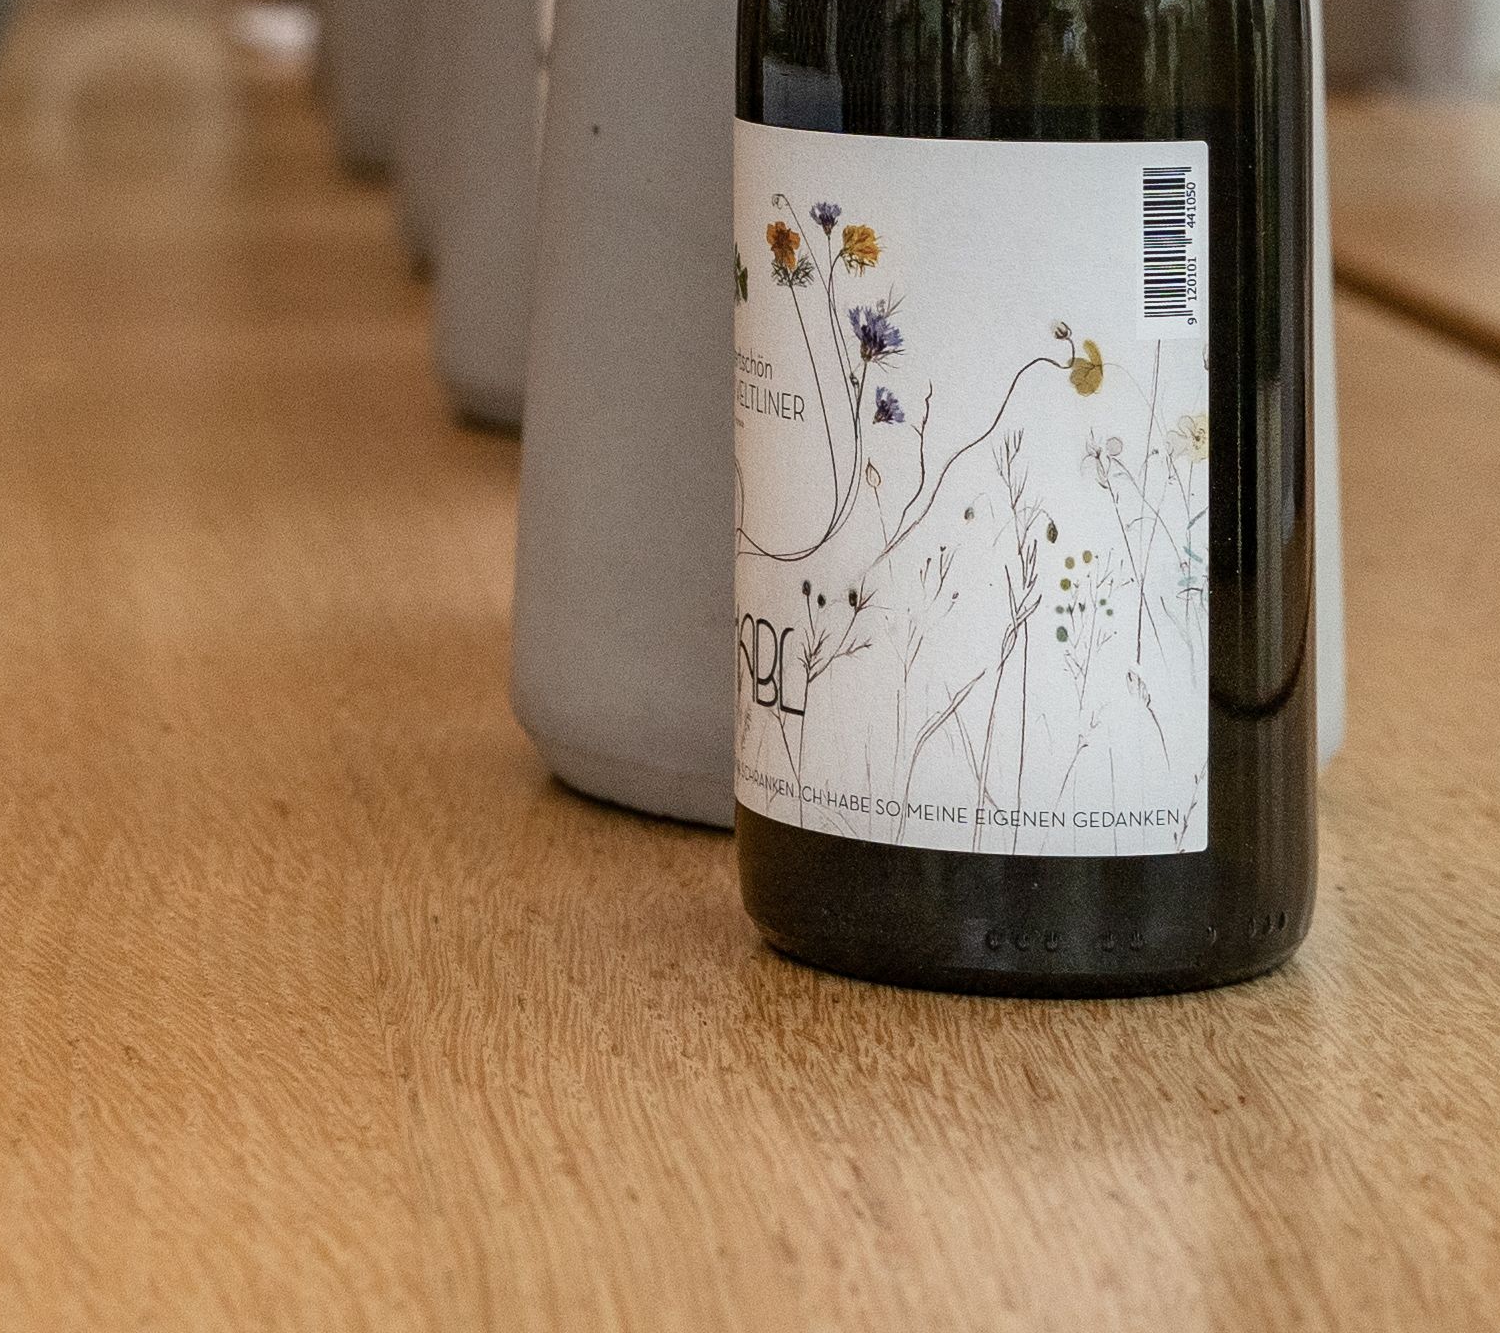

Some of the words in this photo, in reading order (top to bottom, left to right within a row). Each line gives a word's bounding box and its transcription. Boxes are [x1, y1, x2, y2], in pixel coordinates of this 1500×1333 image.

[1186, 181, 1197, 229] 441050
[1187, 256, 1197, 302] 120101
[737, 379, 805, 423] ELTLINER
[826, 790, 871, 814] HABE
[875, 797, 902, 818] SO
[906, 802, 969, 825] MEINE
[974, 808, 1066, 828] EIGENEN
[1072, 808, 1181, 829] GEDANKEN
